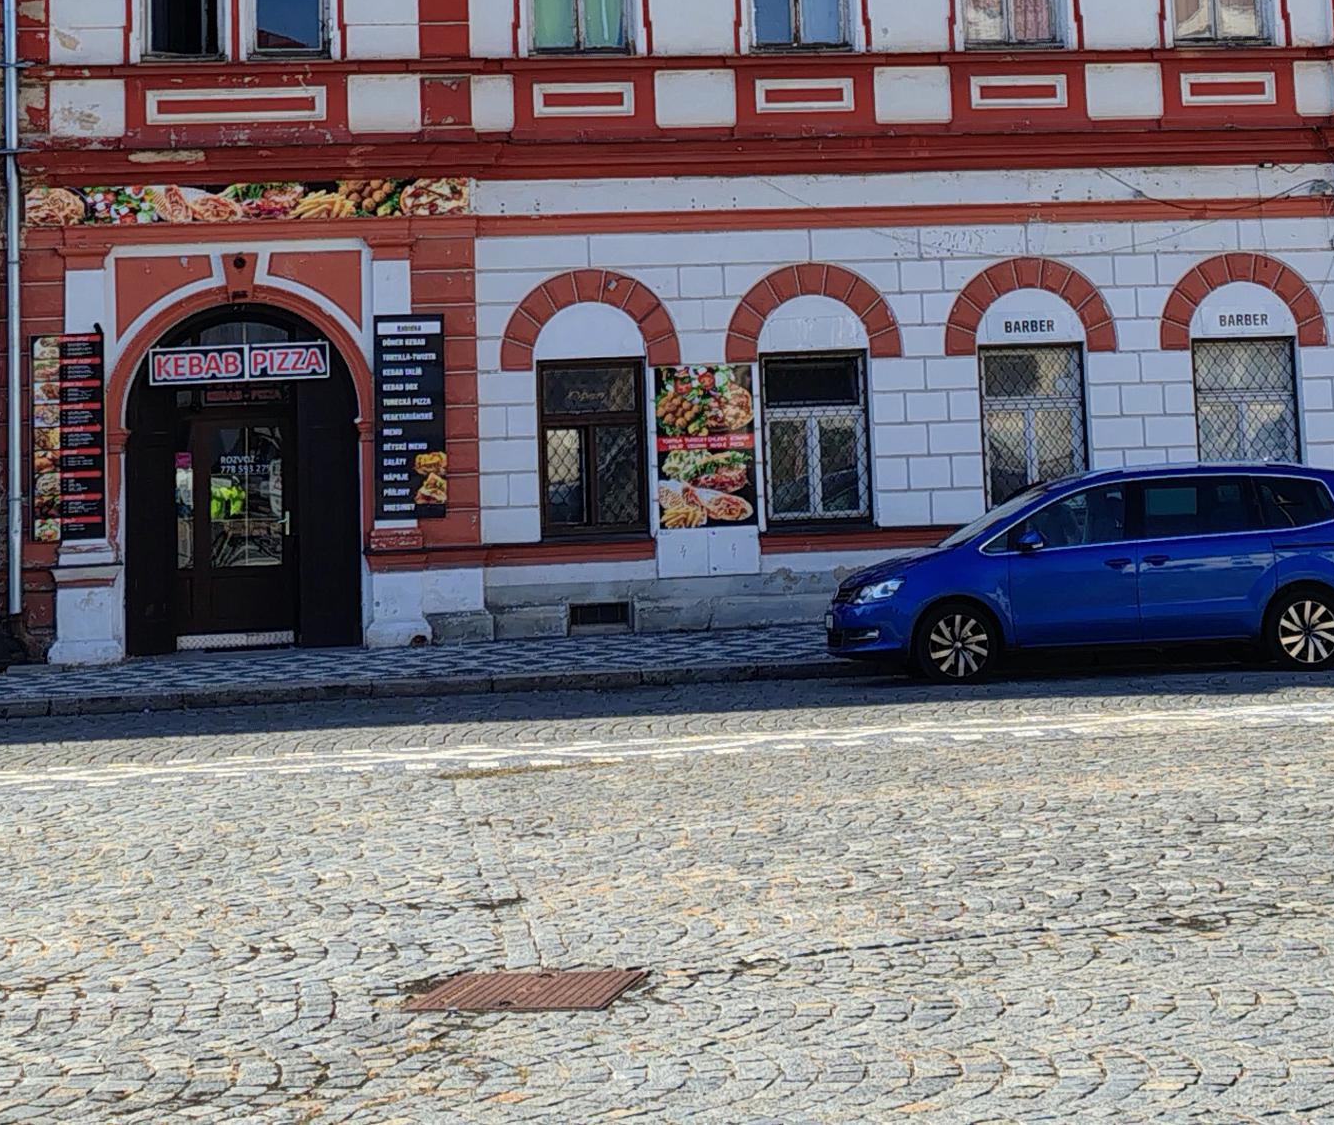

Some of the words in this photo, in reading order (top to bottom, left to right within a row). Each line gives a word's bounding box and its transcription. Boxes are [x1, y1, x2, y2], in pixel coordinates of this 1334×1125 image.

[1004, 320, 1055, 333] BARBER
[1219, 314, 1269, 326] BARBER
[154, 352, 242, 380] KEBAB
[251, 346, 325, 374] PIZZA
